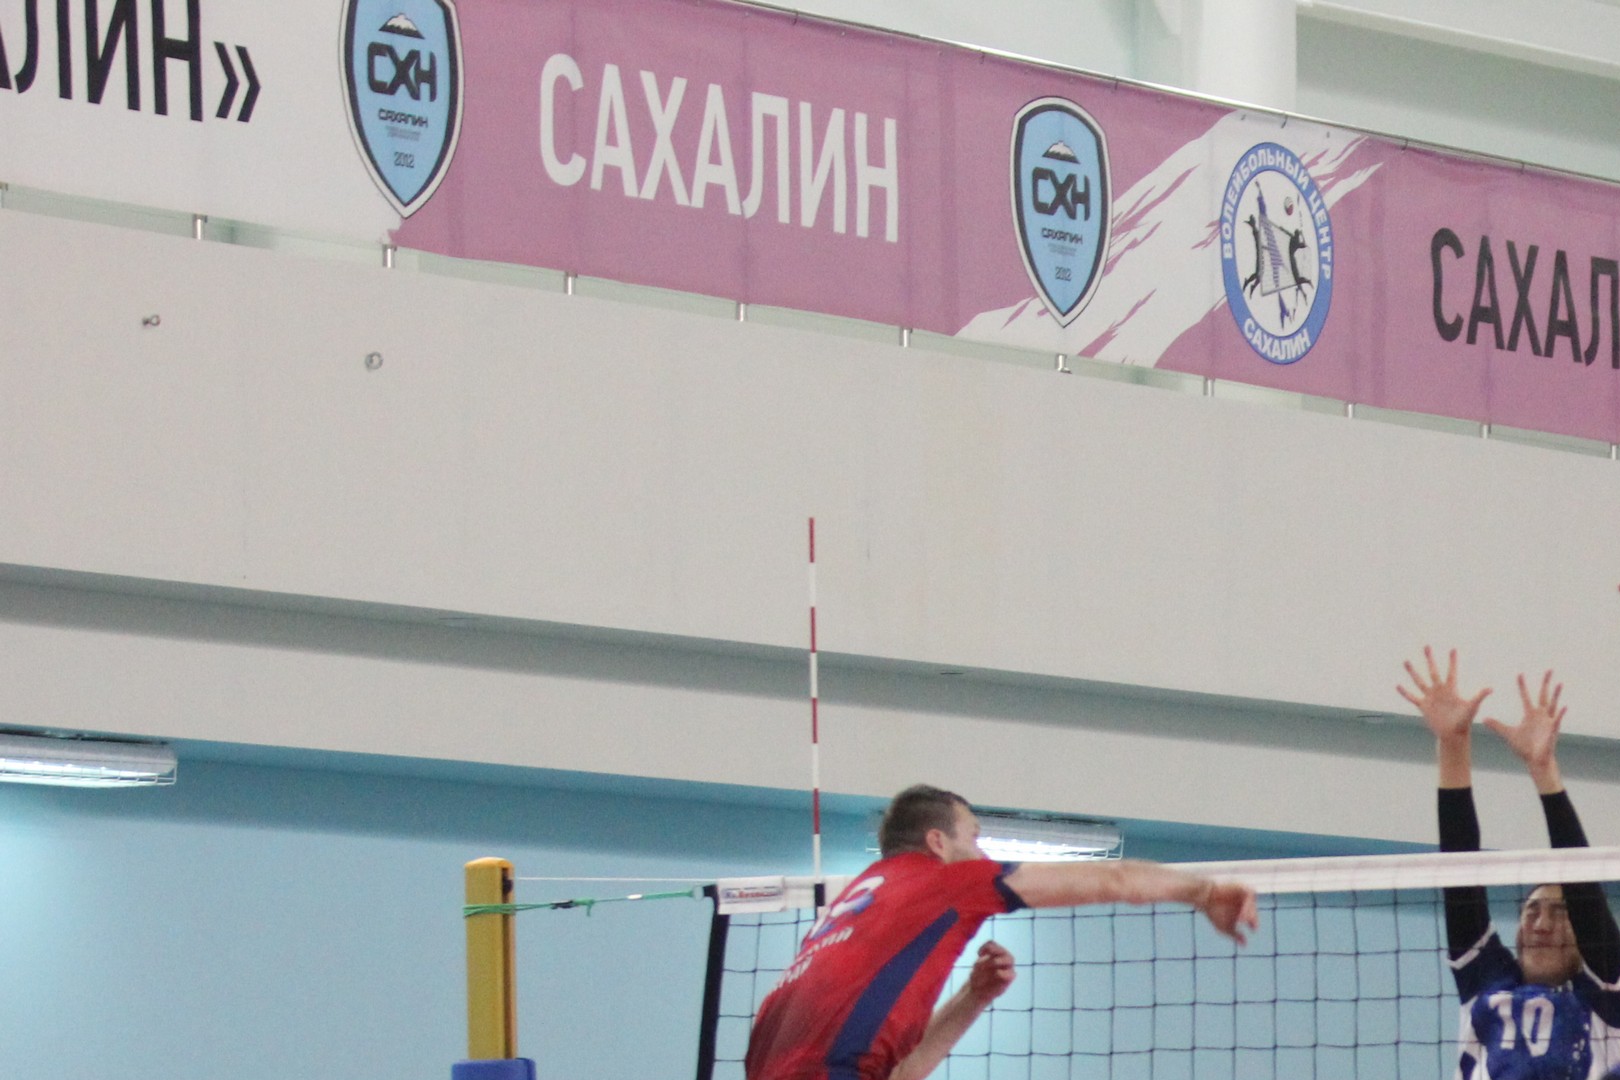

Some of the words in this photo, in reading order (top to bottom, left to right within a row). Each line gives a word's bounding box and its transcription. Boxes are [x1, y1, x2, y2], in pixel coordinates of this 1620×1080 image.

[0, 0, 261, 122] ЛИН»
[540, 53, 898, 243] САХАЛИН
[1221, 148, 1310, 259] ВОЛЕЙБОЛЬНЫЙ
[1308, 189, 1332, 280] ЦЕНТР
[1243, 318, 1311, 361] САХАЛИН
[1488, 990, 1556, 1057] 10
